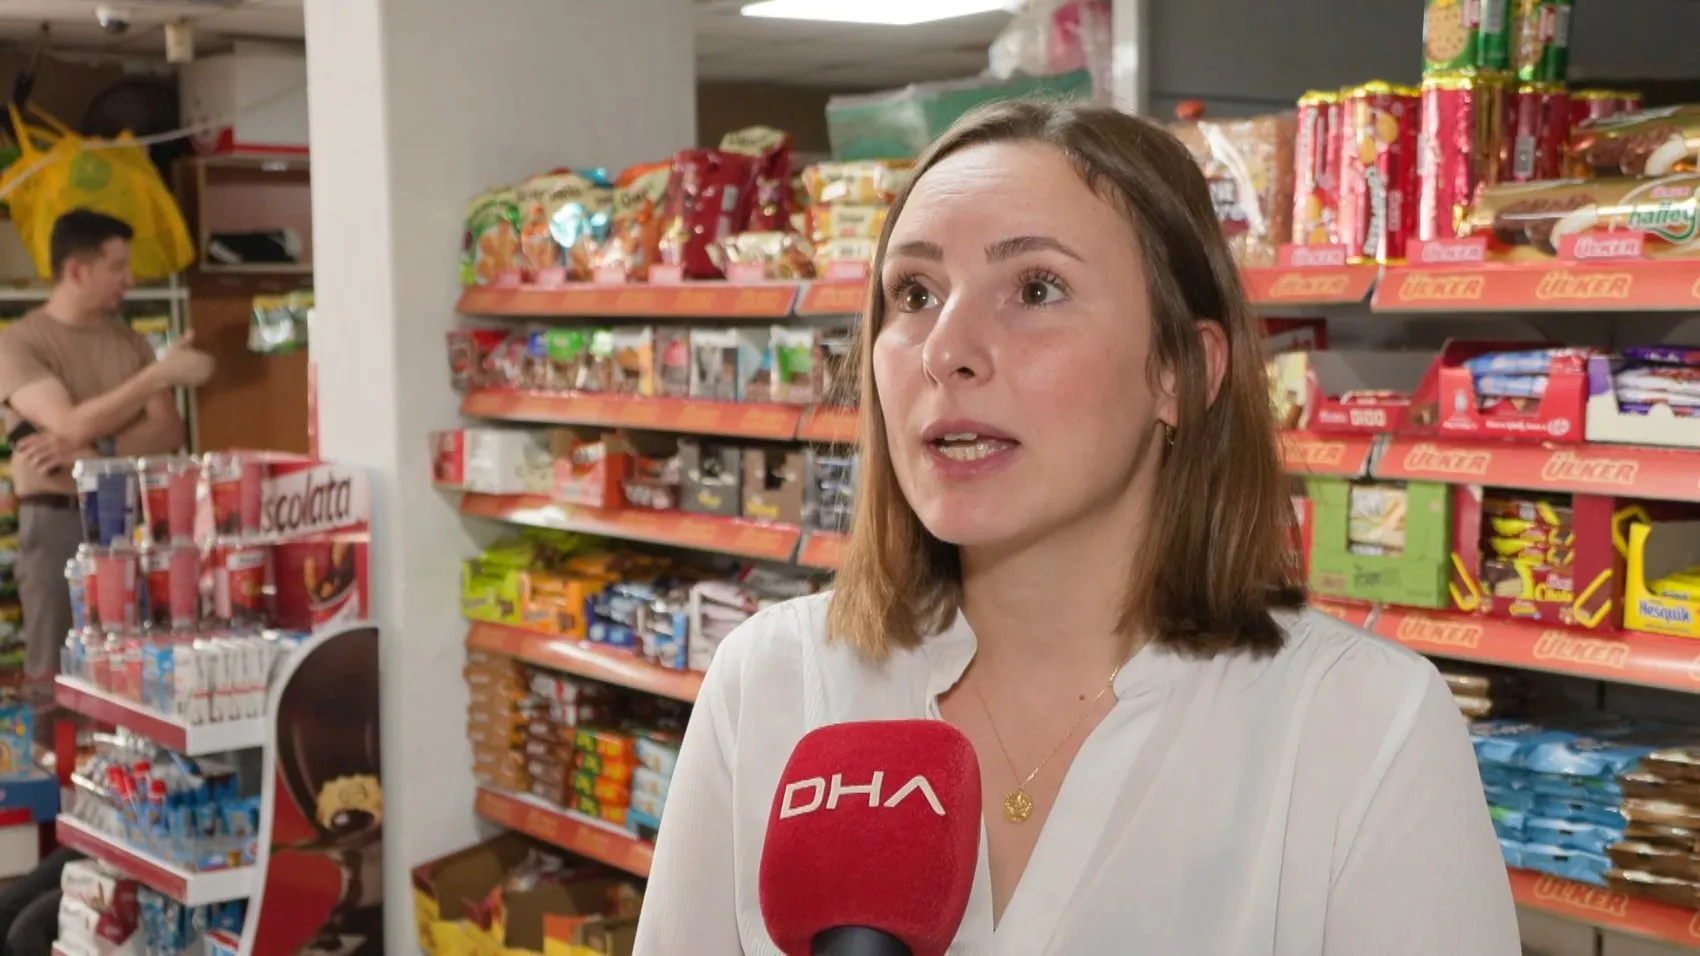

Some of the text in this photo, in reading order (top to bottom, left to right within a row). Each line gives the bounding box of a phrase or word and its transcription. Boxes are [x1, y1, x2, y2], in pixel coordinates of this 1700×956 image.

[1573, 236, 1641, 258] ÜLKER
[1399, 270, 1484, 301] ÜLKER
[1536, 270, 1632, 300] ÜLKER
[1404, 443, 1491, 475] ÜLKER
[1542, 451, 1639, 484] ÜLKER
[262, 472, 352, 533] scolata
[1639, 600, 1691, 624] Nesquik
[1397, 614, 1483, 648] ÜLKER
[1534, 629, 1629, 669] ÜLKER
[779, 771, 946, 820] DHA
